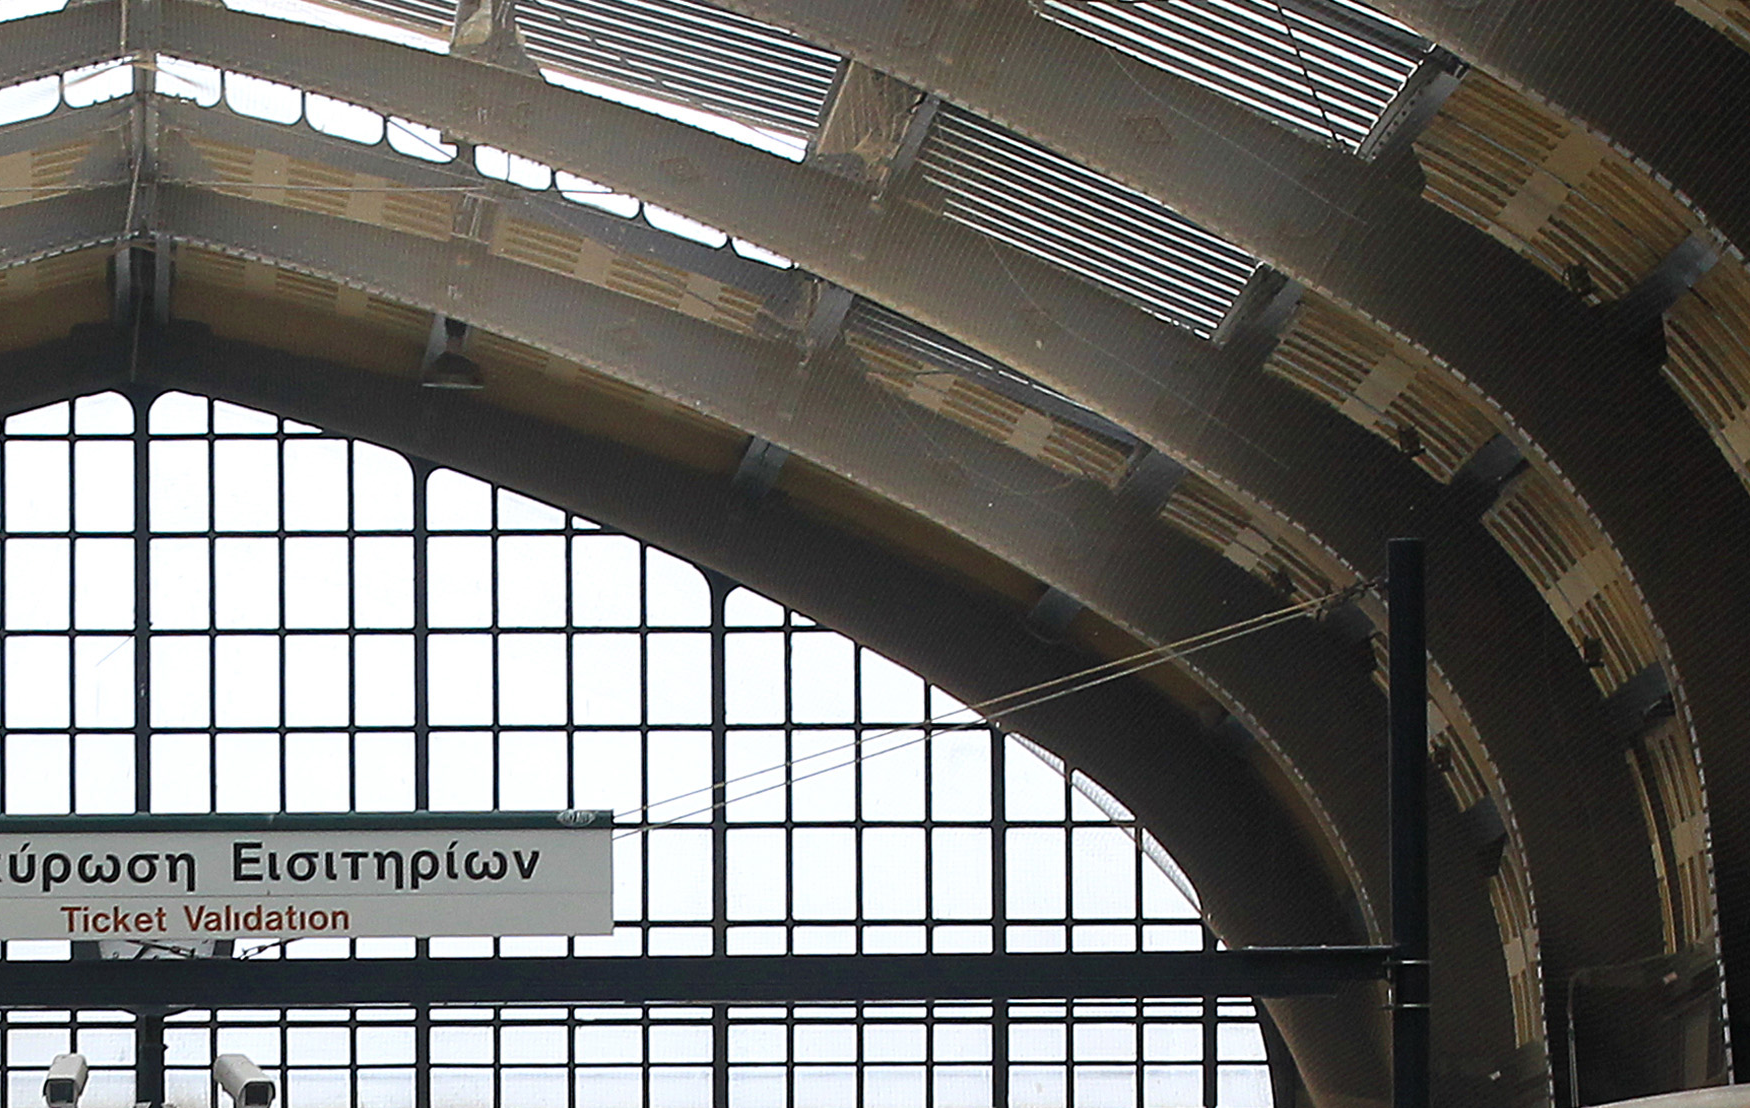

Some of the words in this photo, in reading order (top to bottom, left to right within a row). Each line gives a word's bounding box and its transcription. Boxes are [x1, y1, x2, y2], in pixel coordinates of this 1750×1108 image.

[233, 840, 540, 890] Εισιτηρίων
[60, 905, 167, 934] Ticket
[184, 904, 349, 935] Validation
